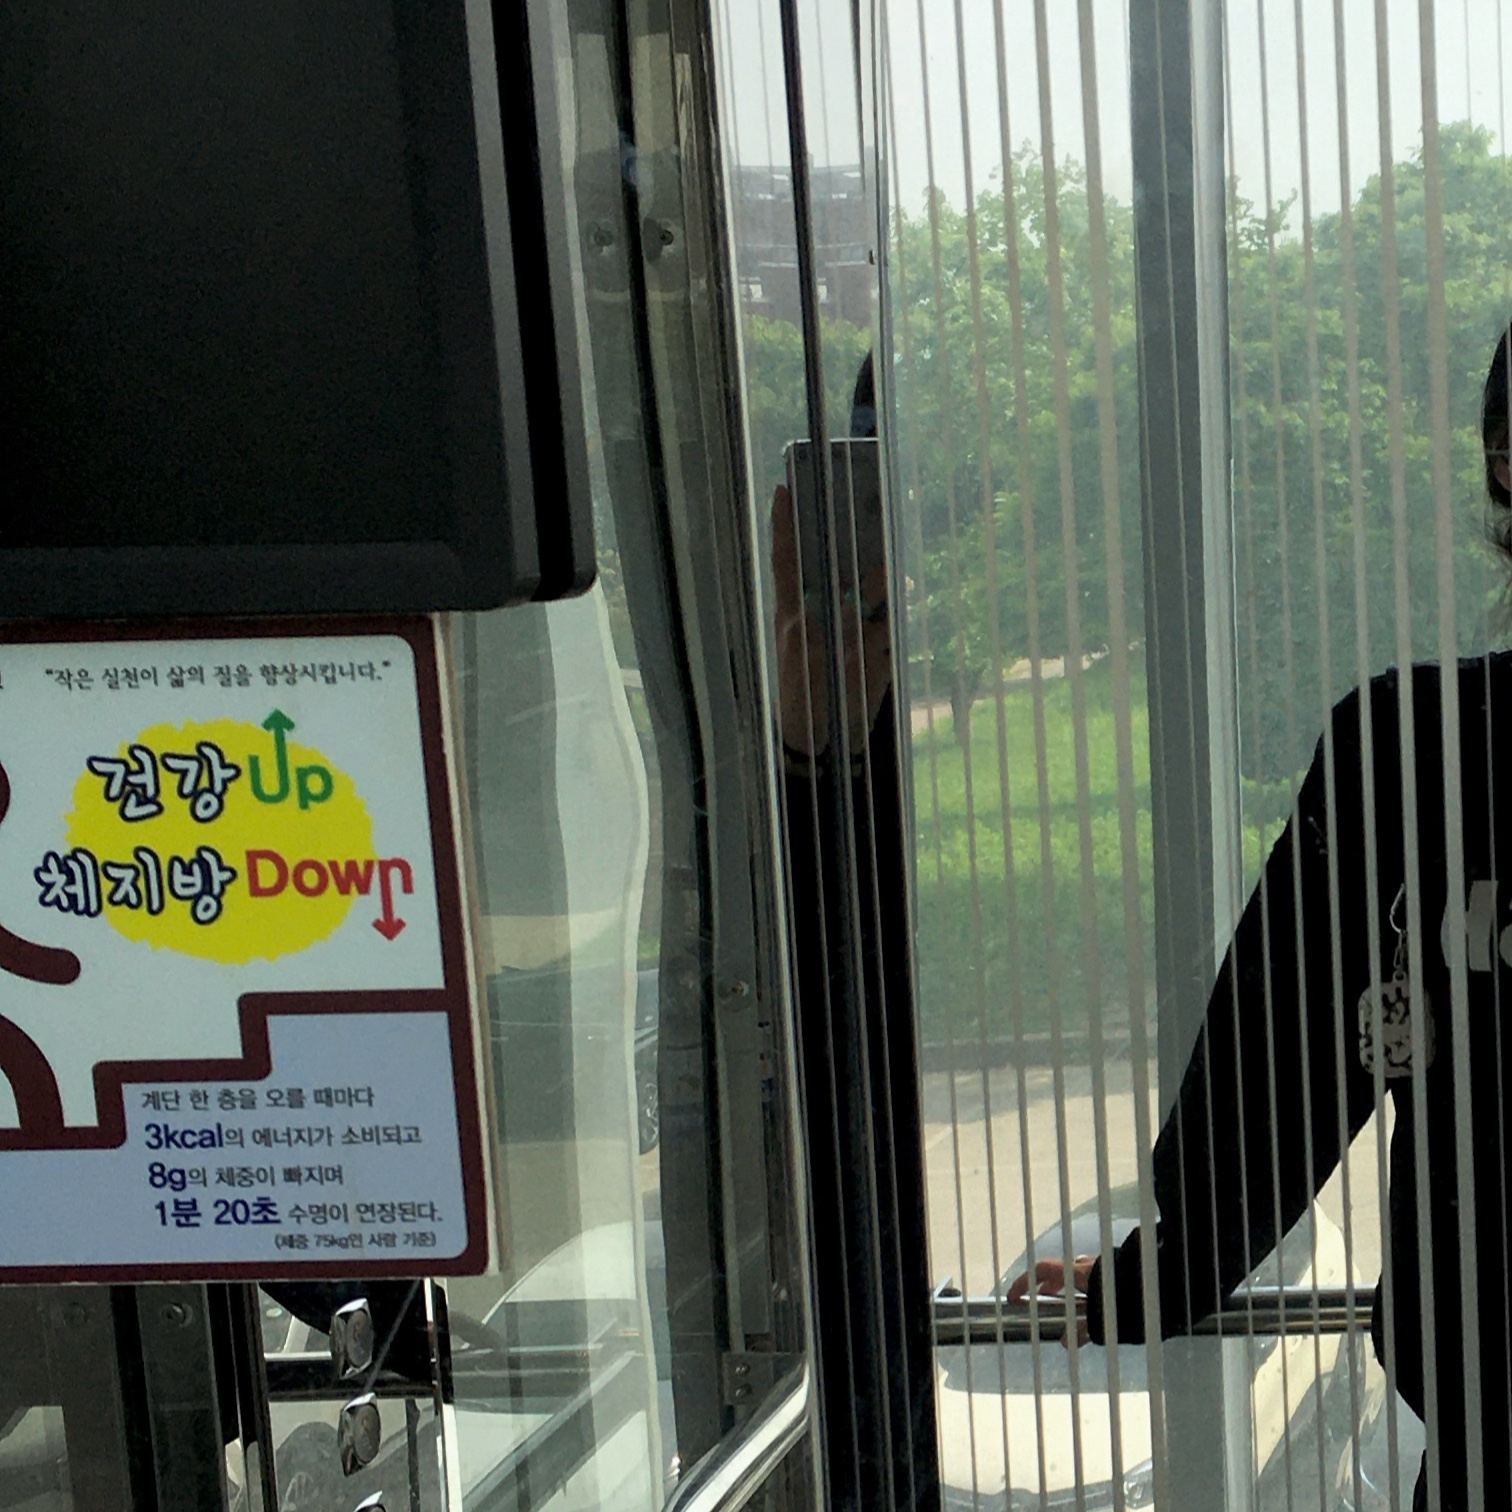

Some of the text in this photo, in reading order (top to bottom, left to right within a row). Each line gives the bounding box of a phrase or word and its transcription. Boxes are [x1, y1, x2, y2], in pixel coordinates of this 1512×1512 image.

[102, 665, 159, 690] 실천이
[166, 664, 206, 689] 삶의
[212, 663, 253, 688] 질을
[87, 741, 333, 823] 건강 Up
[33, 846, 415, 925] 체지방 Down
[141, 1086, 375, 1111] 계단 한 층을 오를 때마다
[144, 1121, 422, 1151] 3kcal의 에너지가 소비되고
[148, 1161, 344, 1192] 8g의 체중이 빠지며
[154, 1196, 443, 1228] 1분 20초 수명이 연장된다.
